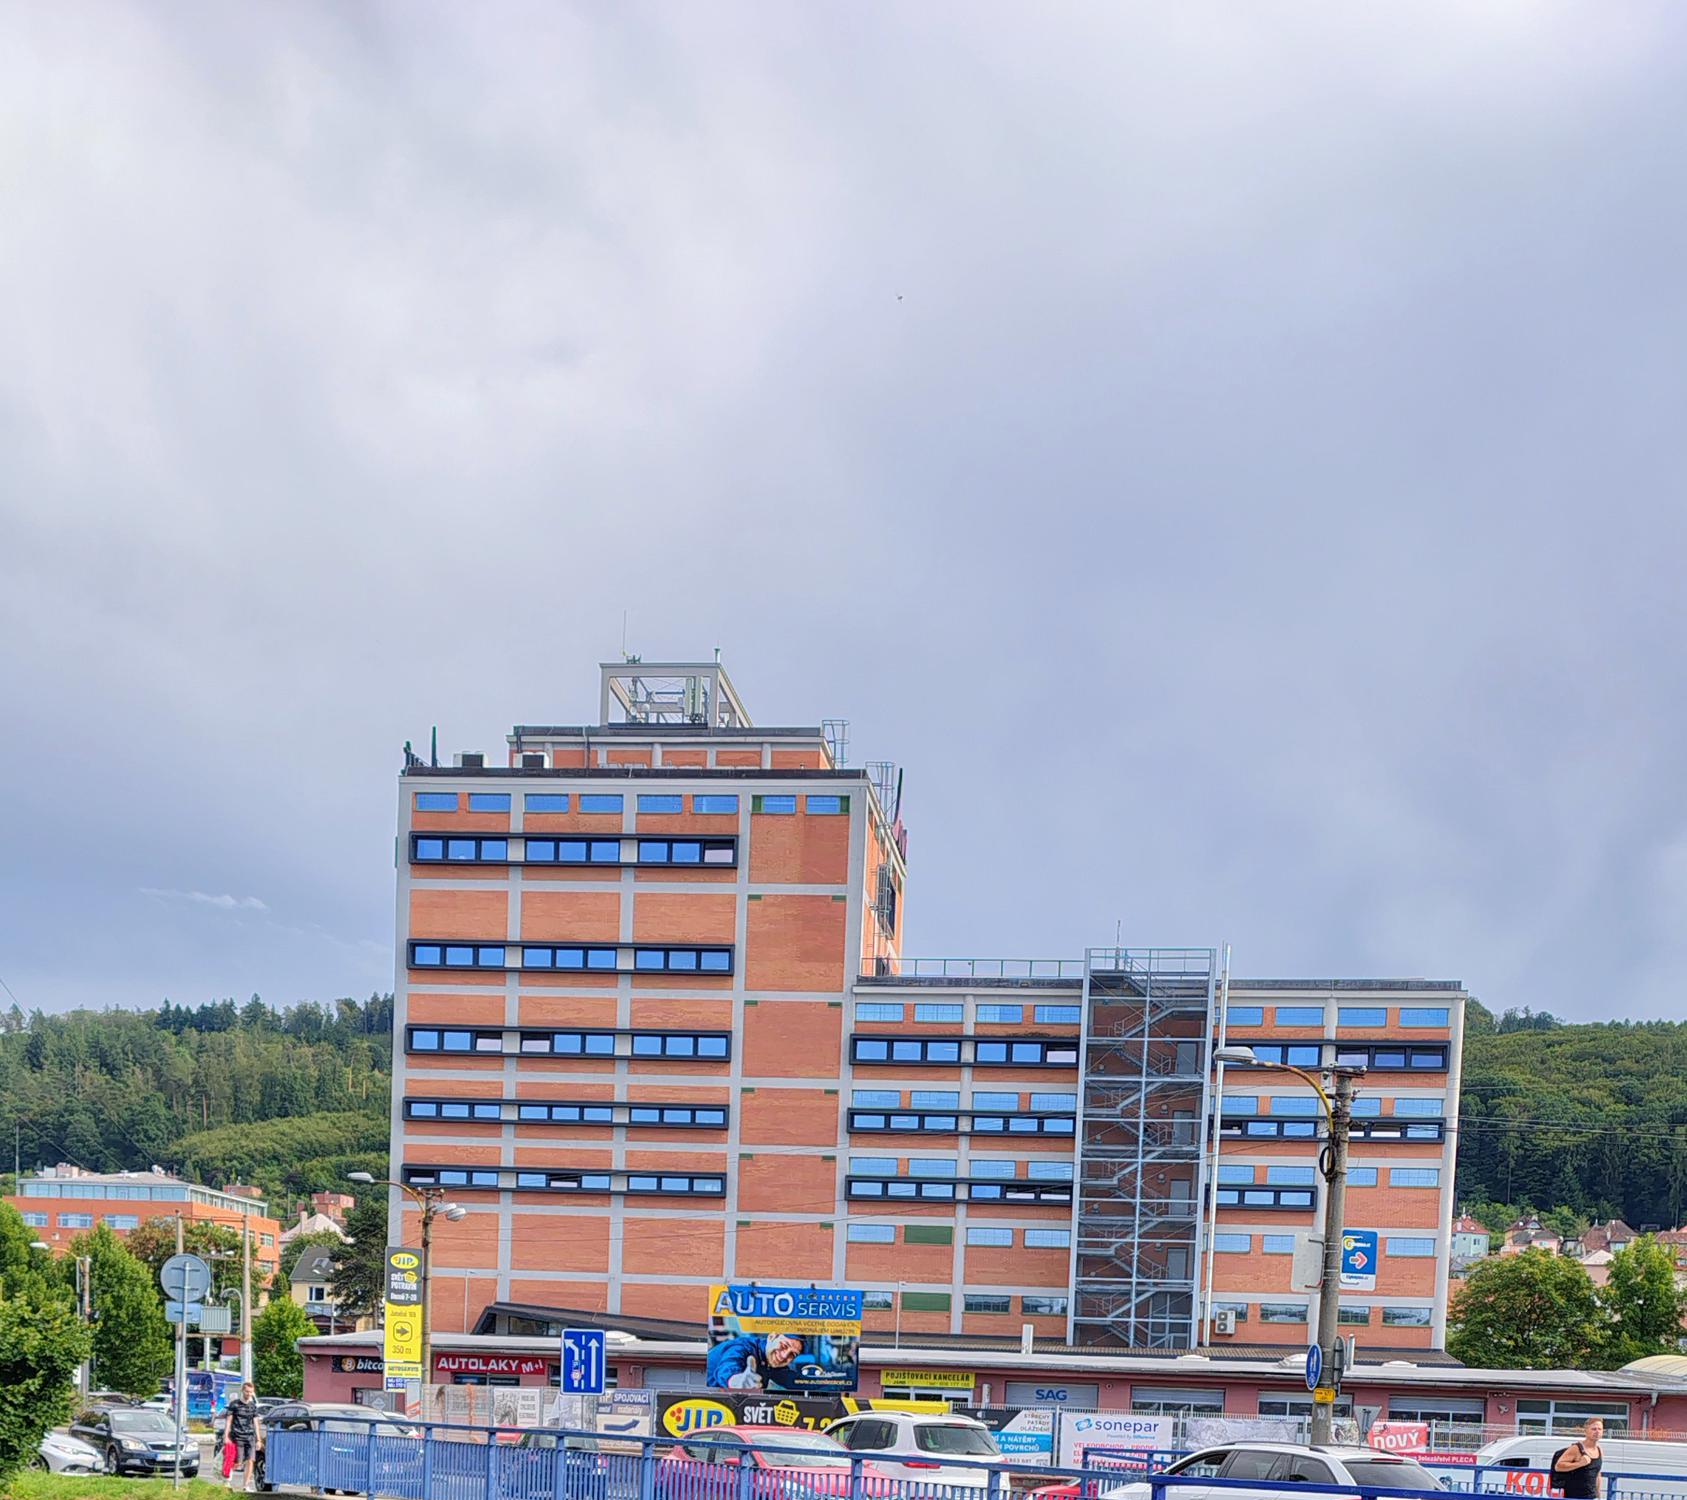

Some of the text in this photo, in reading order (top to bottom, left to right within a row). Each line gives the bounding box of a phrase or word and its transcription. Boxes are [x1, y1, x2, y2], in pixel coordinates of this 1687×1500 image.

[714, 1290, 794, 1316] AUTO
[798, 1302, 856, 1317] SERVIS
[392, 1345, 404, 1354] 350
[356, 1359, 384, 1372] bitco
[438, 1357, 519, 1371] AUTOLAKY
[1035, 1389, 1067, 1401] SAG
[676, 1408, 723, 1431] JIP
[743, 1402, 773, 1424] SVĚT
[1095, 1420, 1159, 1433] sonepar
[1008, 1434, 1036, 1442] NÁTĚRY
[1004, 1443, 1040, 1451] POVRCHŮ
